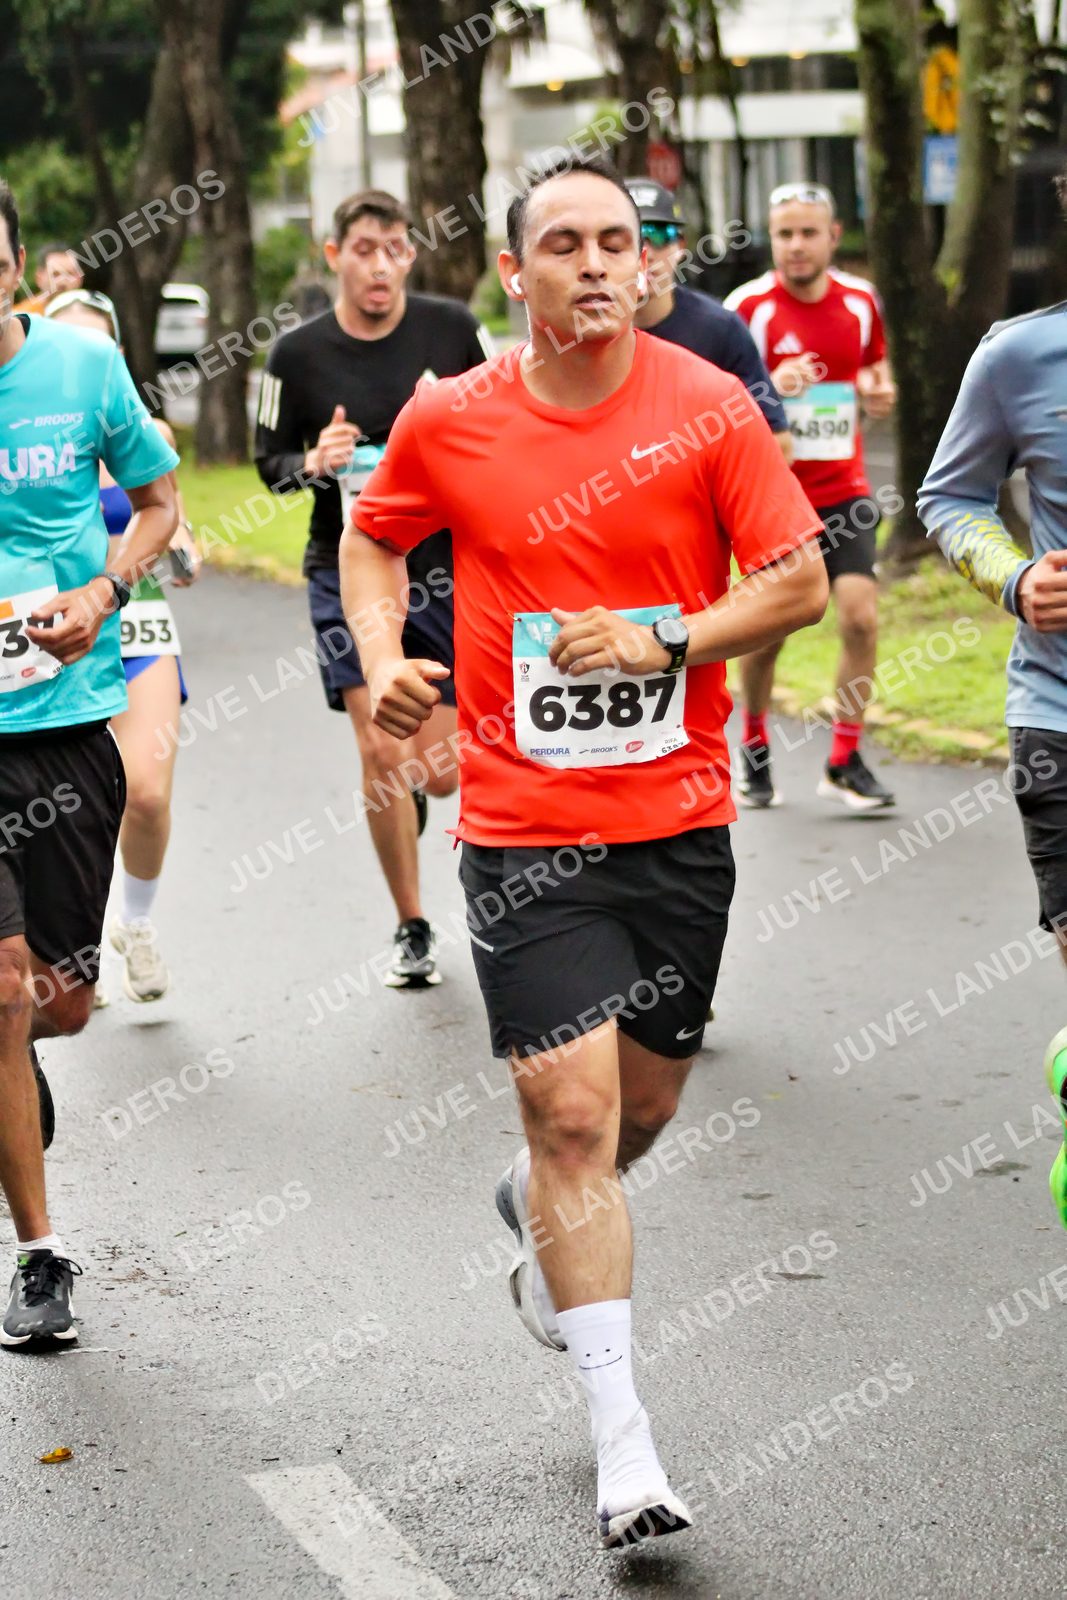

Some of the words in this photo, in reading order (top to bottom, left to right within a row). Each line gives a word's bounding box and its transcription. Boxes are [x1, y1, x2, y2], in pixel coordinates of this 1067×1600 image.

[33, 412, 85, 428] BROOKS
[529, 674, 678, 733] 6387
[529, 747, 571, 756] PERDURA
[590, 745, 618, 754] BROOKS
